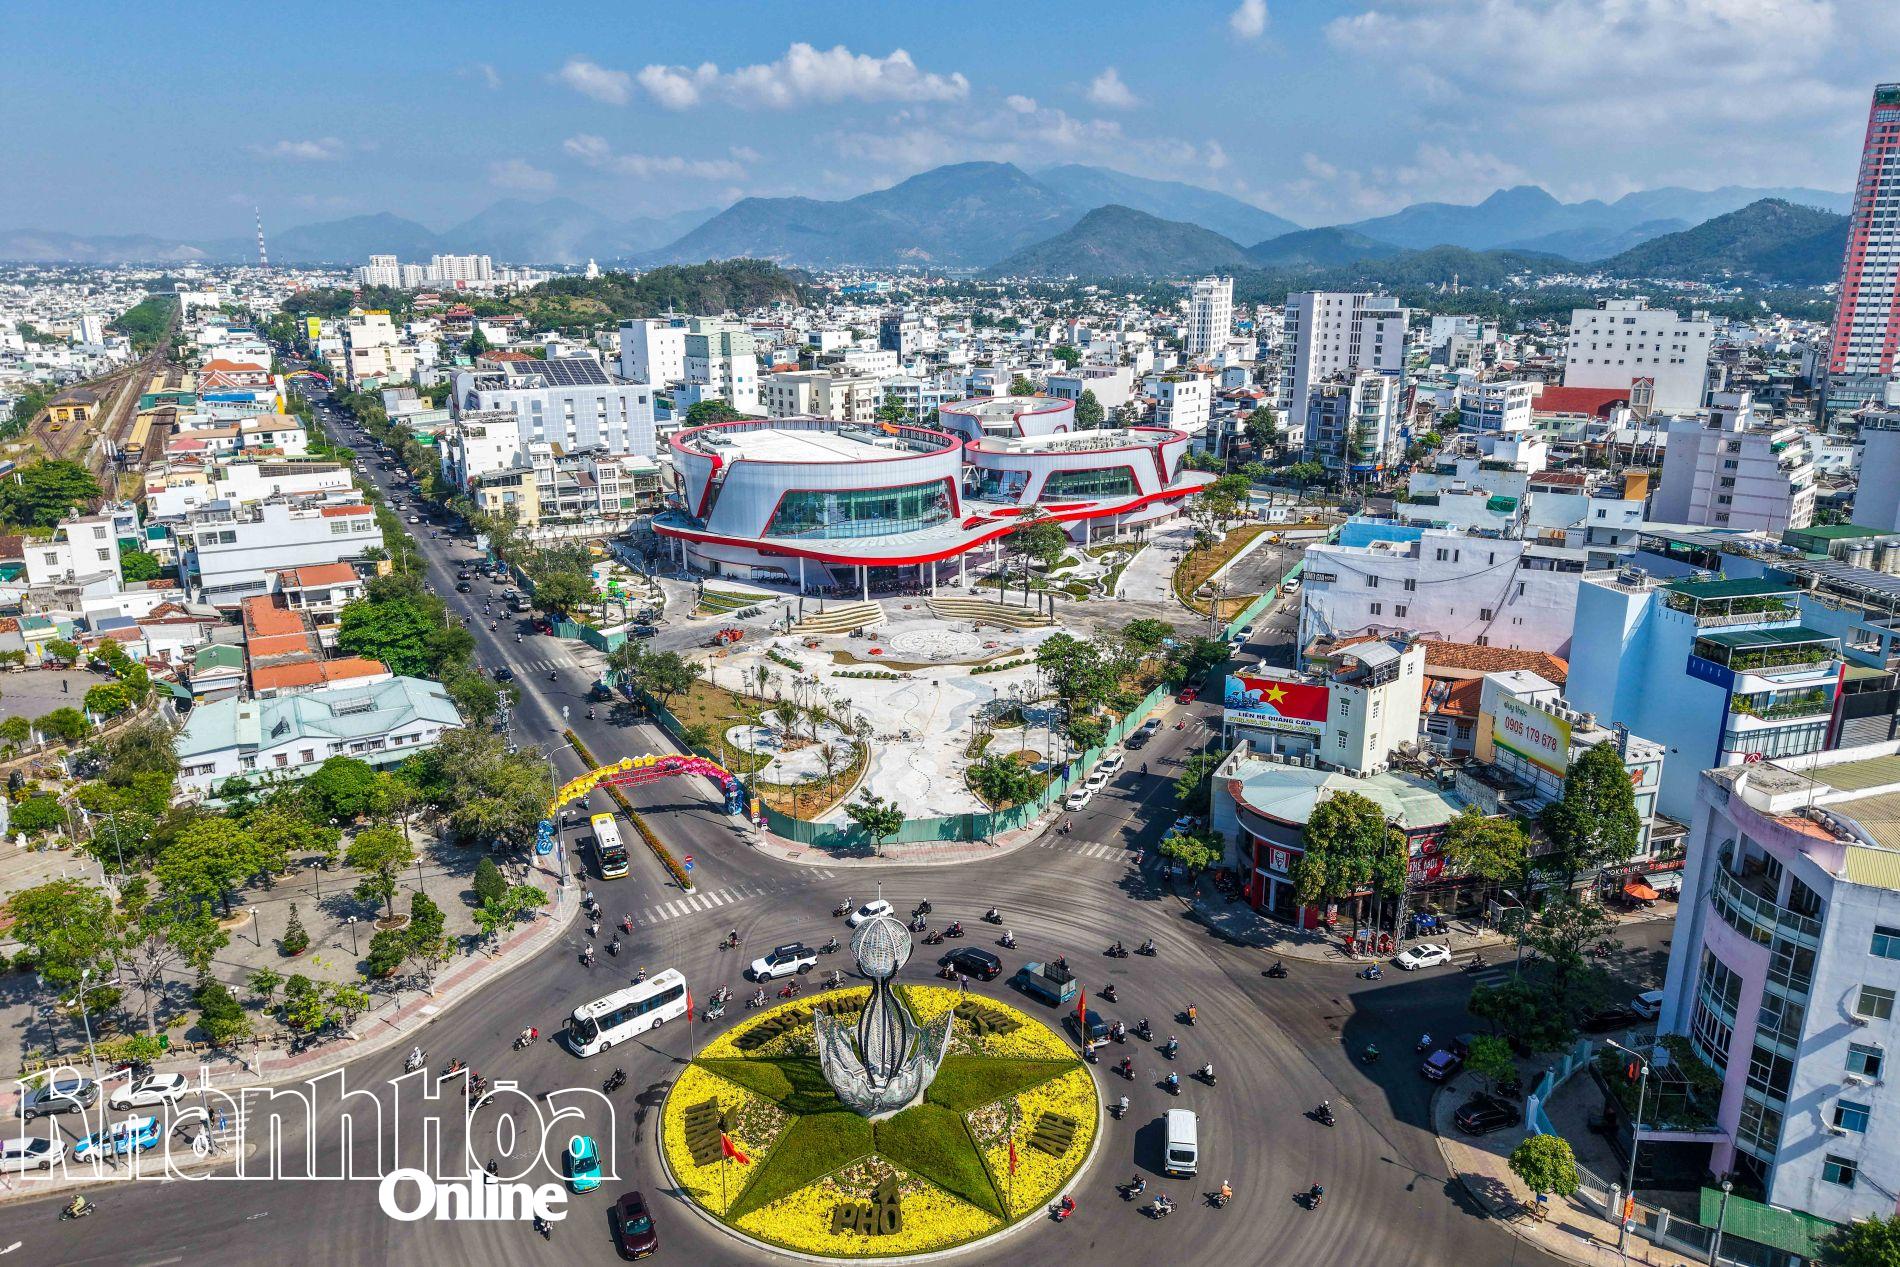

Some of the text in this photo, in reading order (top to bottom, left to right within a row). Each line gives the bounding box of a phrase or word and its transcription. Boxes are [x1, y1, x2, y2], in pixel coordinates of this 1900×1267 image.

[1504, 716, 1557, 751] 0905 179 678
